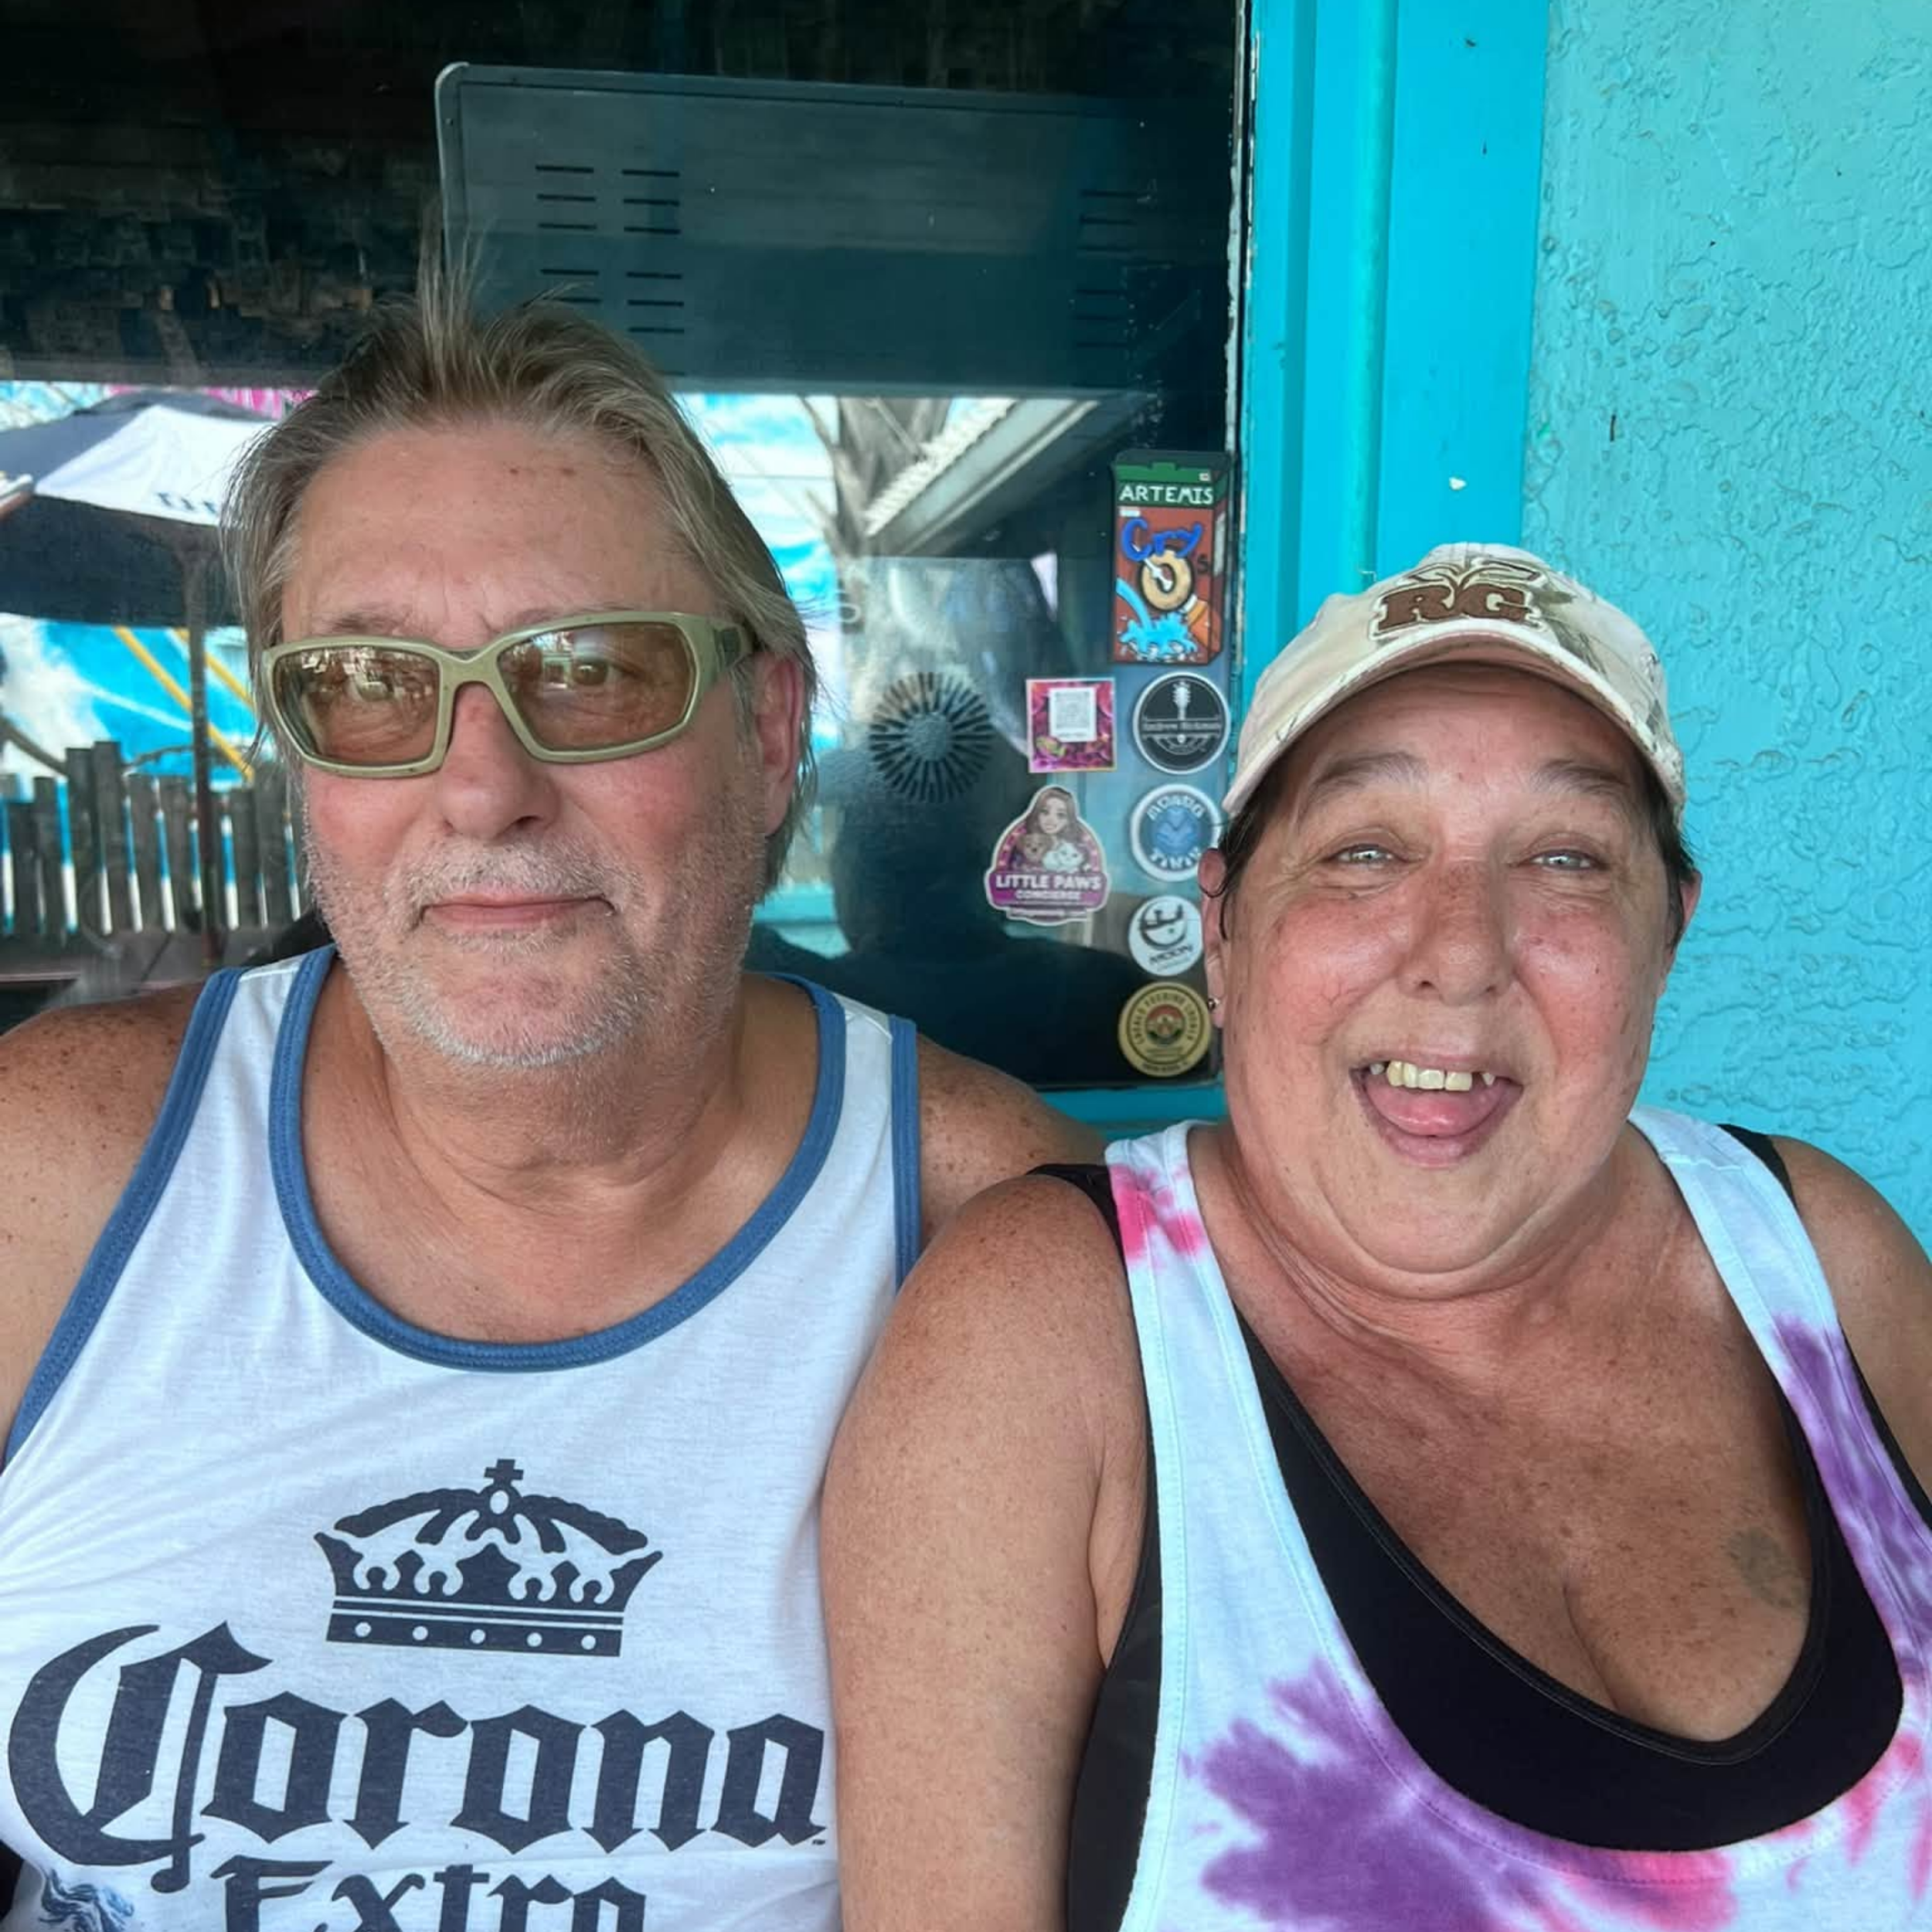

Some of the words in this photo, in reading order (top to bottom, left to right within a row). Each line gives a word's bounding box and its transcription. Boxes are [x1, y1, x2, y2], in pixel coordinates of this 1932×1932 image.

[1119, 485, 1213, 504] ARTEMIS
[1376, 583, 1532, 632] RG
[996, 875, 1049, 888] LITTLE
[1054, 876, 1102, 889] PAWS
[8, 1621, 827, 1893] Corona
